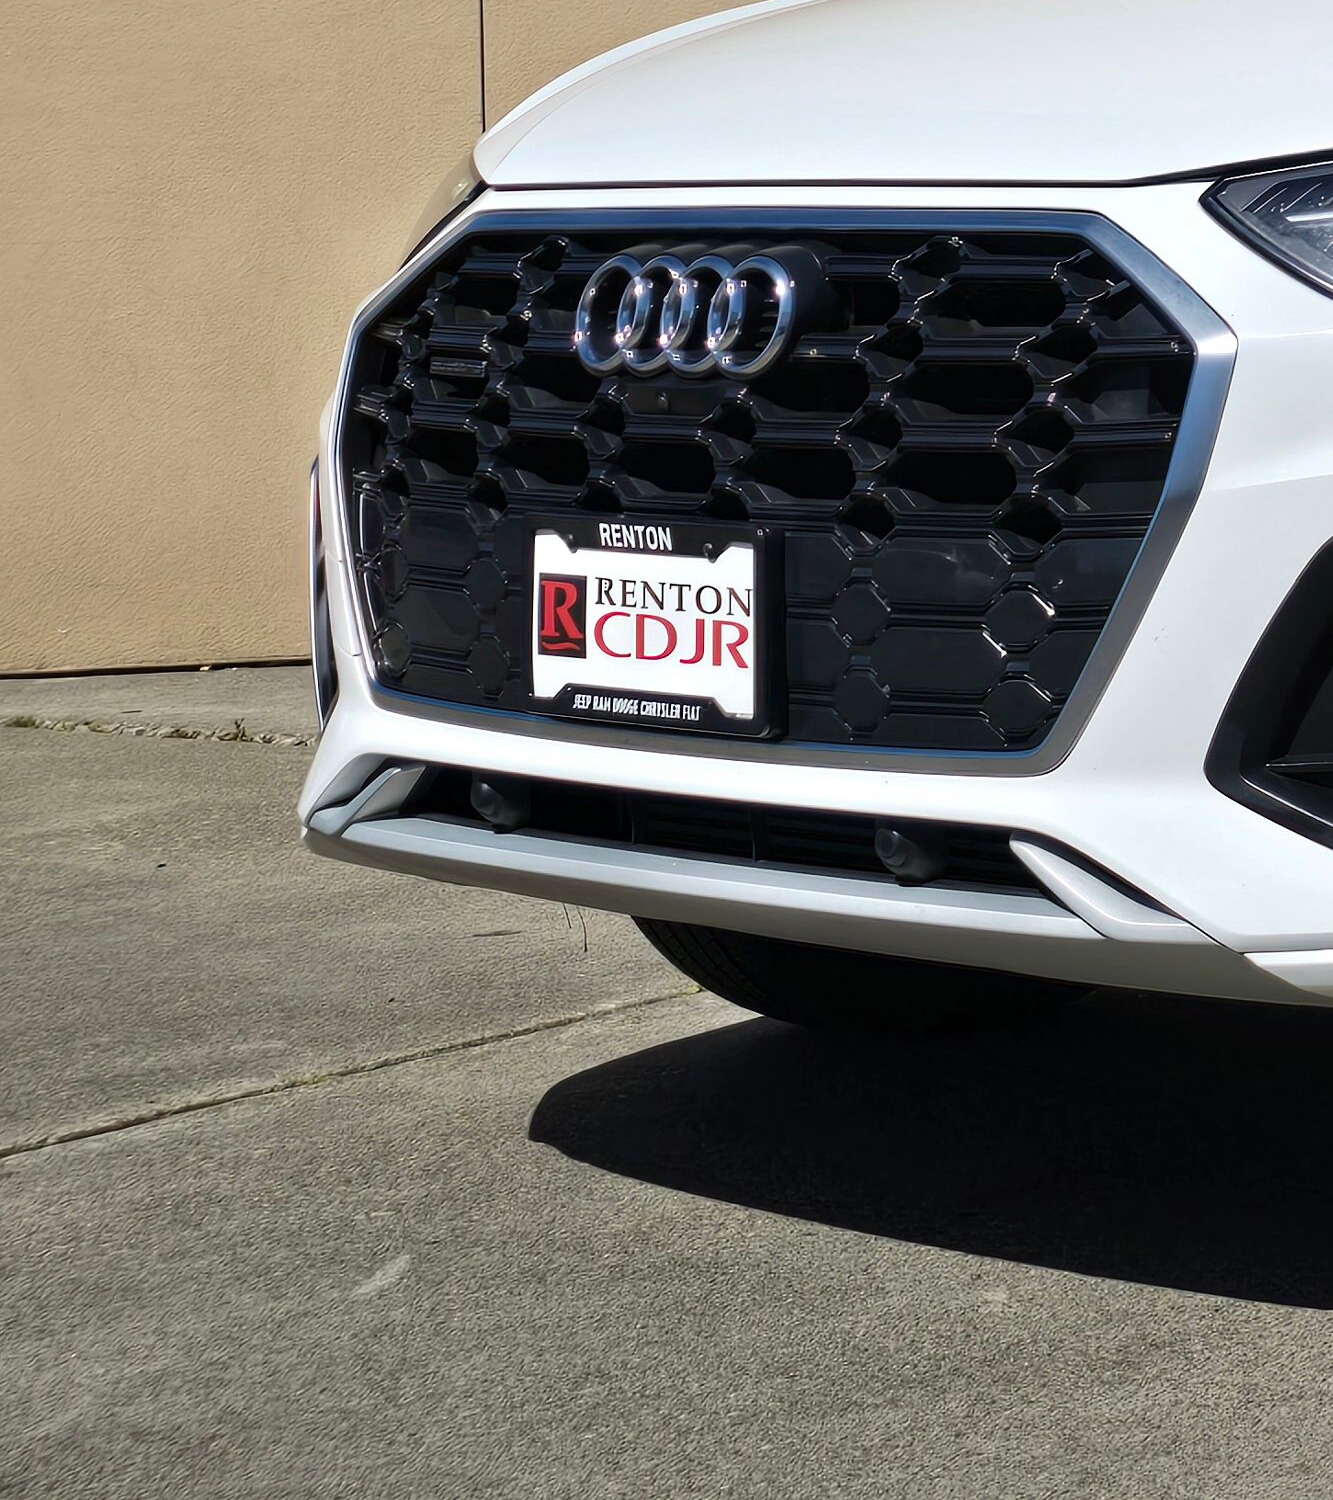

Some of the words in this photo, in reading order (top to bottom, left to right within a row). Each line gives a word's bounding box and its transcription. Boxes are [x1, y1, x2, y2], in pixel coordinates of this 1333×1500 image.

[599, 522, 673, 551] RENTON
[540, 580, 584, 639] R
[595, 577, 752, 617] RENTON
[594, 611, 749, 668] CDJR
